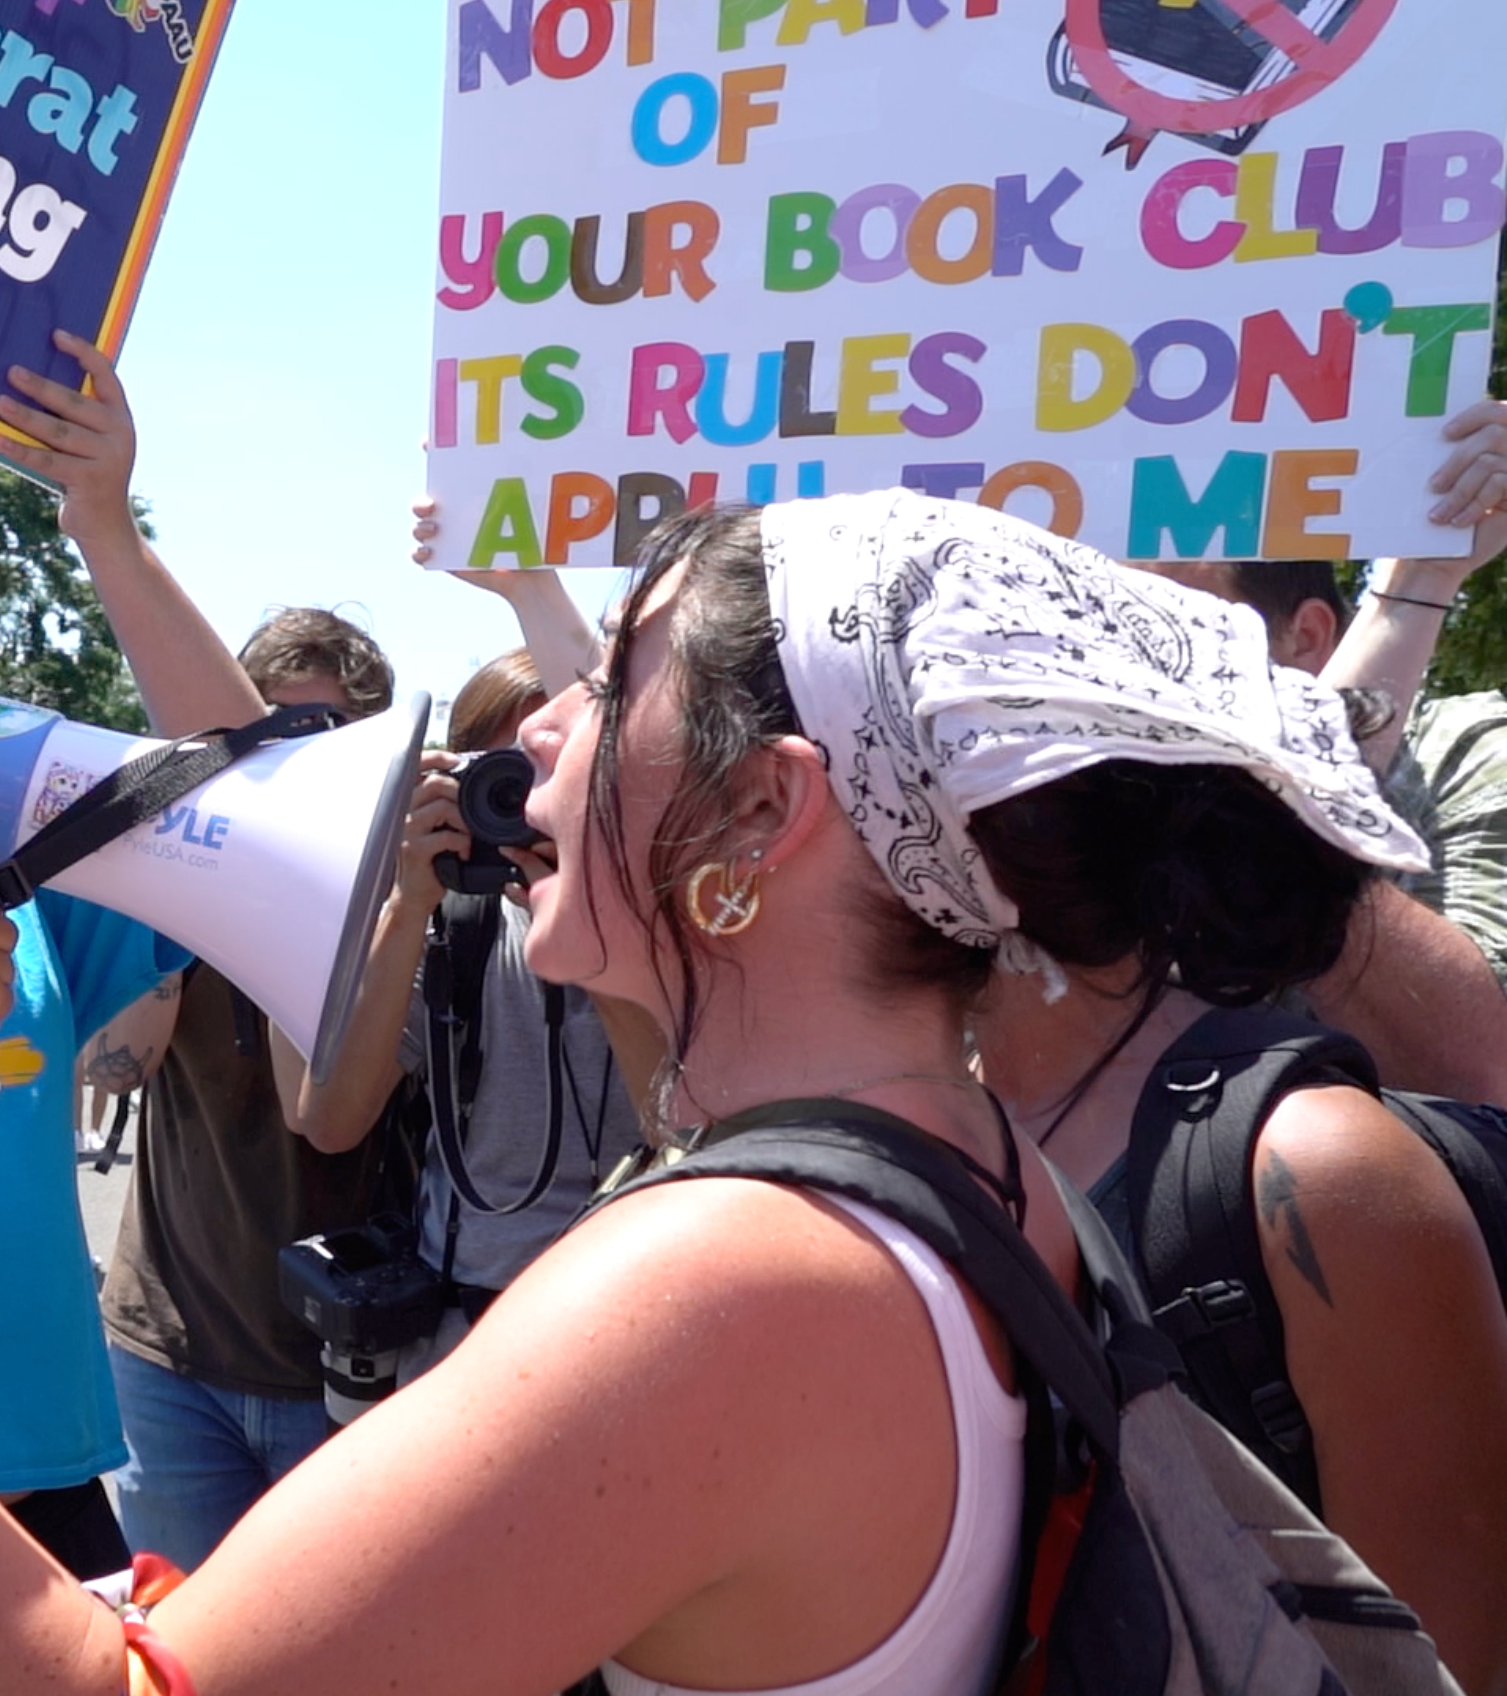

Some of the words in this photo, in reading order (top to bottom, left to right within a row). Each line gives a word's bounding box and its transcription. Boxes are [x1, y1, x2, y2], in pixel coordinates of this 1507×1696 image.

[459, 0, 659, 92] NOT
[631, 64, 786, 167] OF
[436, 201, 720, 310] YOUR
[764, 167, 1083, 291] BOOK
[1140, 130, 1506, 269] CLUB
[435, 345, 584, 447] ITS
[627, 331, 987, 446] RULES
[1035, 281, 1490, 426] DON'T
[1128, 449, 1359, 560] ME
[149, 804, 230, 850] YLE
